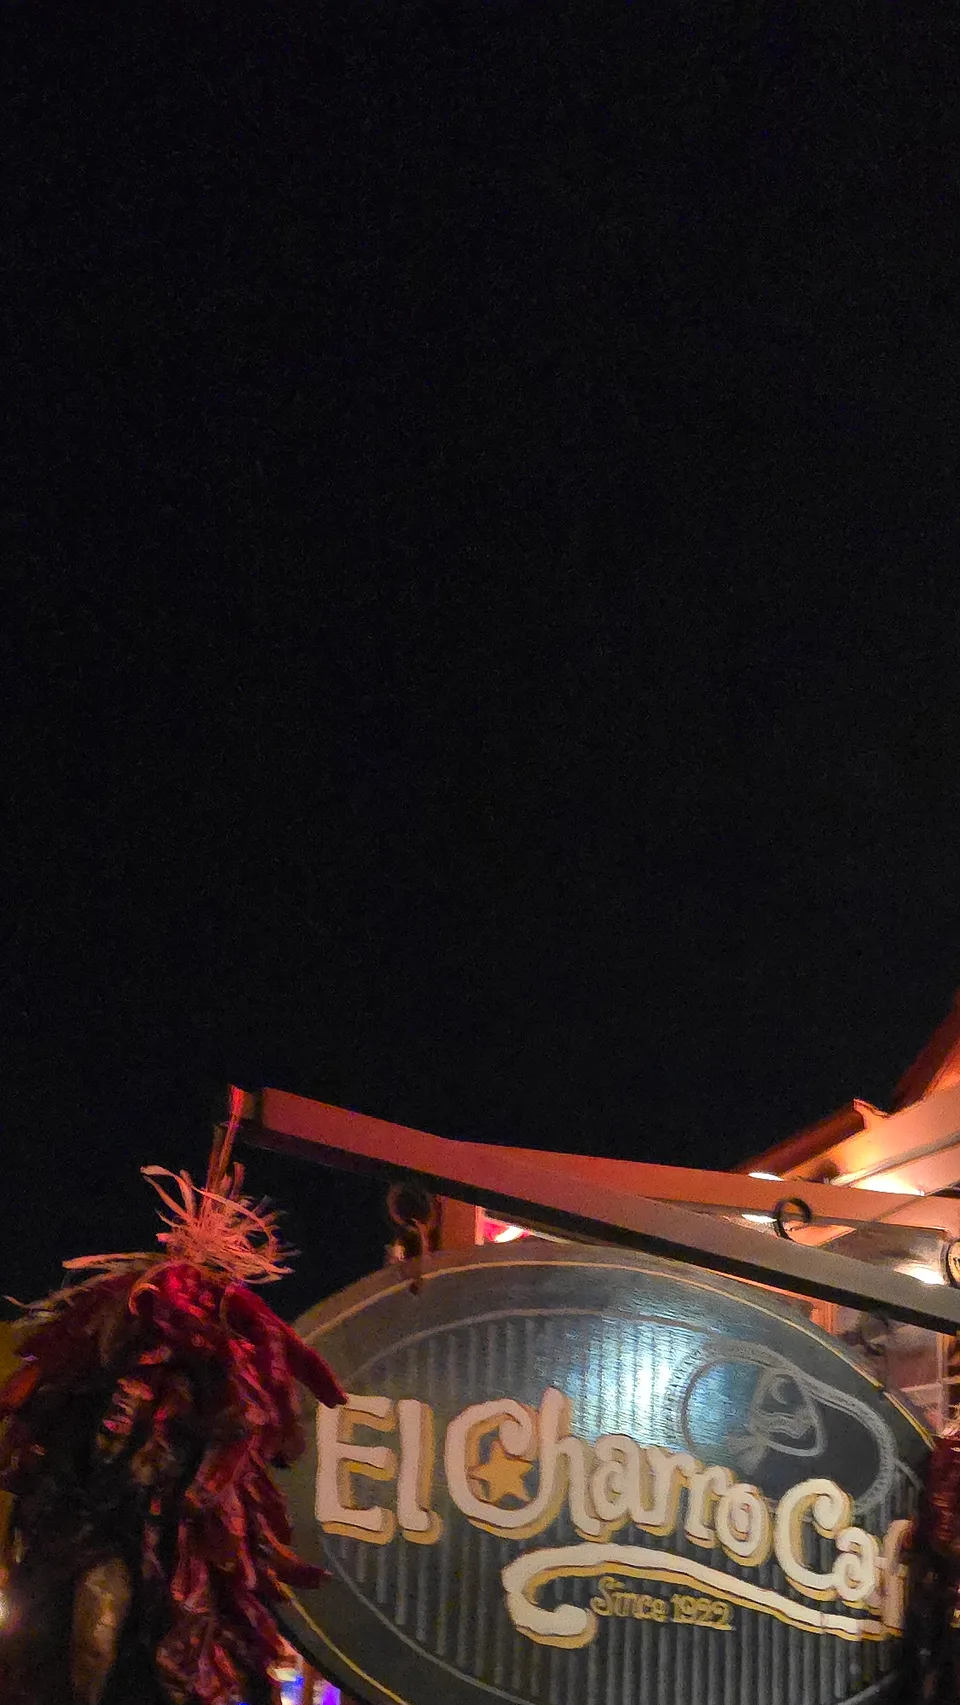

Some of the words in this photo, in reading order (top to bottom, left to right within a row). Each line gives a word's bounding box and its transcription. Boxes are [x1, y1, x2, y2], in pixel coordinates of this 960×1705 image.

[315, 1395, 443, 1545] El
[444, 1386, 770, 1567] Charro
[773, 1477, 913, 1642] Caf
[590, 1576, 669, 1623] Since
[670, 1593, 736, 1631] 1922
